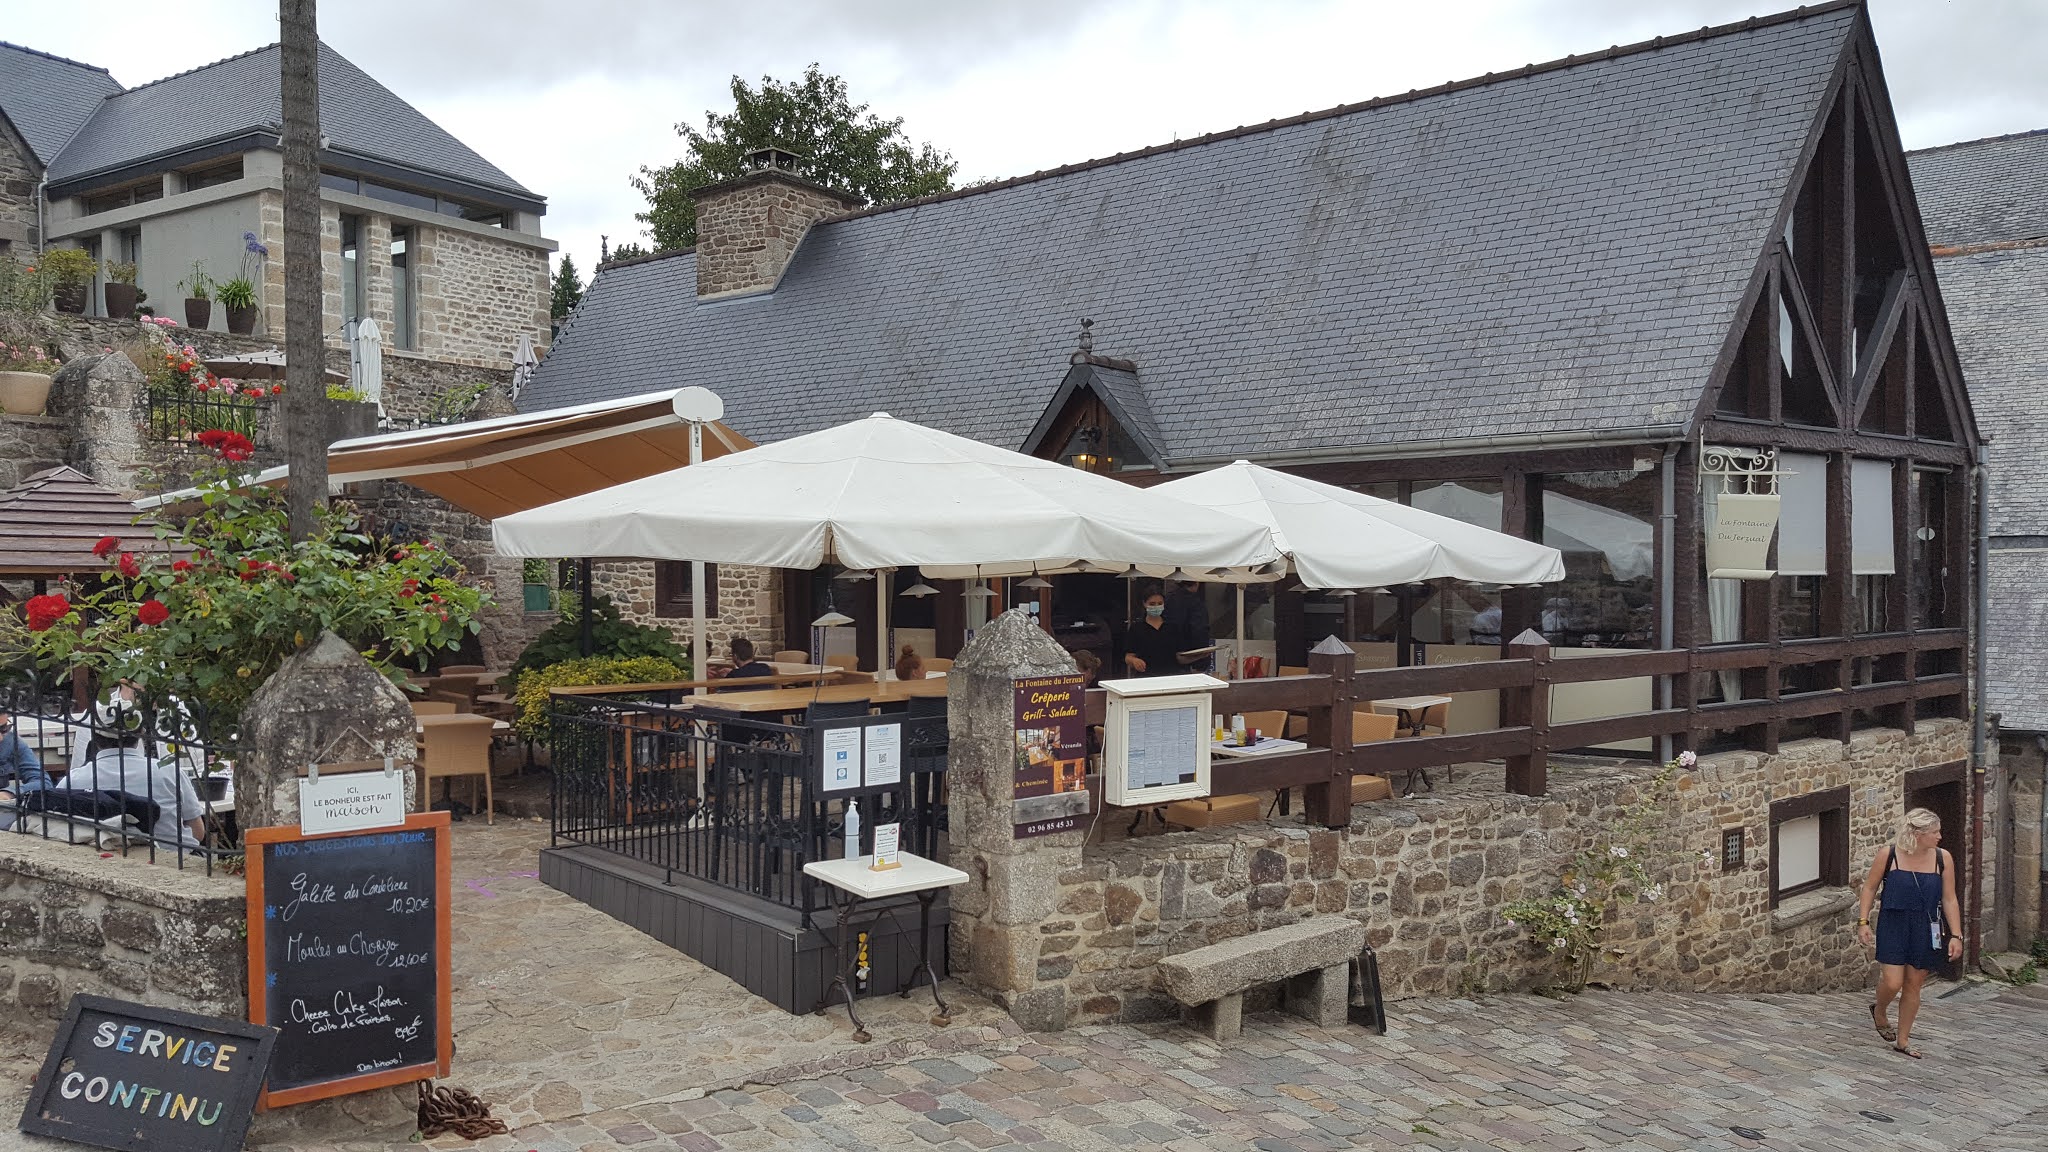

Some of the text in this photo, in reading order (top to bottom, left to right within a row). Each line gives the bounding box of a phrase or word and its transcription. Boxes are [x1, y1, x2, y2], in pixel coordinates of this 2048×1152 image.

[1720, 518, 1772, 527] La Fontaine
[1718, 532, 1767, 543] Du Jerzual
[1015, 675, 1084, 688] La Fontaine du Jerzual
[1030, 691, 1070, 708] Crêperie
[1048, 705, 1078, 719] Salades
[1060, 742, 1082, 750] Véranda
[1022, 779, 1048, 788] Cheminée
[313, 793, 392, 807] LE BONHEUR EST FAIT
[325, 804, 383, 818] maison
[1027, 819, 1074, 833] 02 96 85 45 33
[274, 843, 299, 857] NOS
[304, 838, 377, 854] SUGGESTIONS
[382, 835, 396, 846] DU
[283, 872, 337, 922] Galette
[287, 933, 331, 962] Moules
[291, 999, 331, 1023] Cheese
[334, 990, 367, 1016] Cake
[340, 1015, 356, 1029] de
[93, 1021, 237, 1072] SERVICE
[61, 1072, 223, 1126] CONTINU
